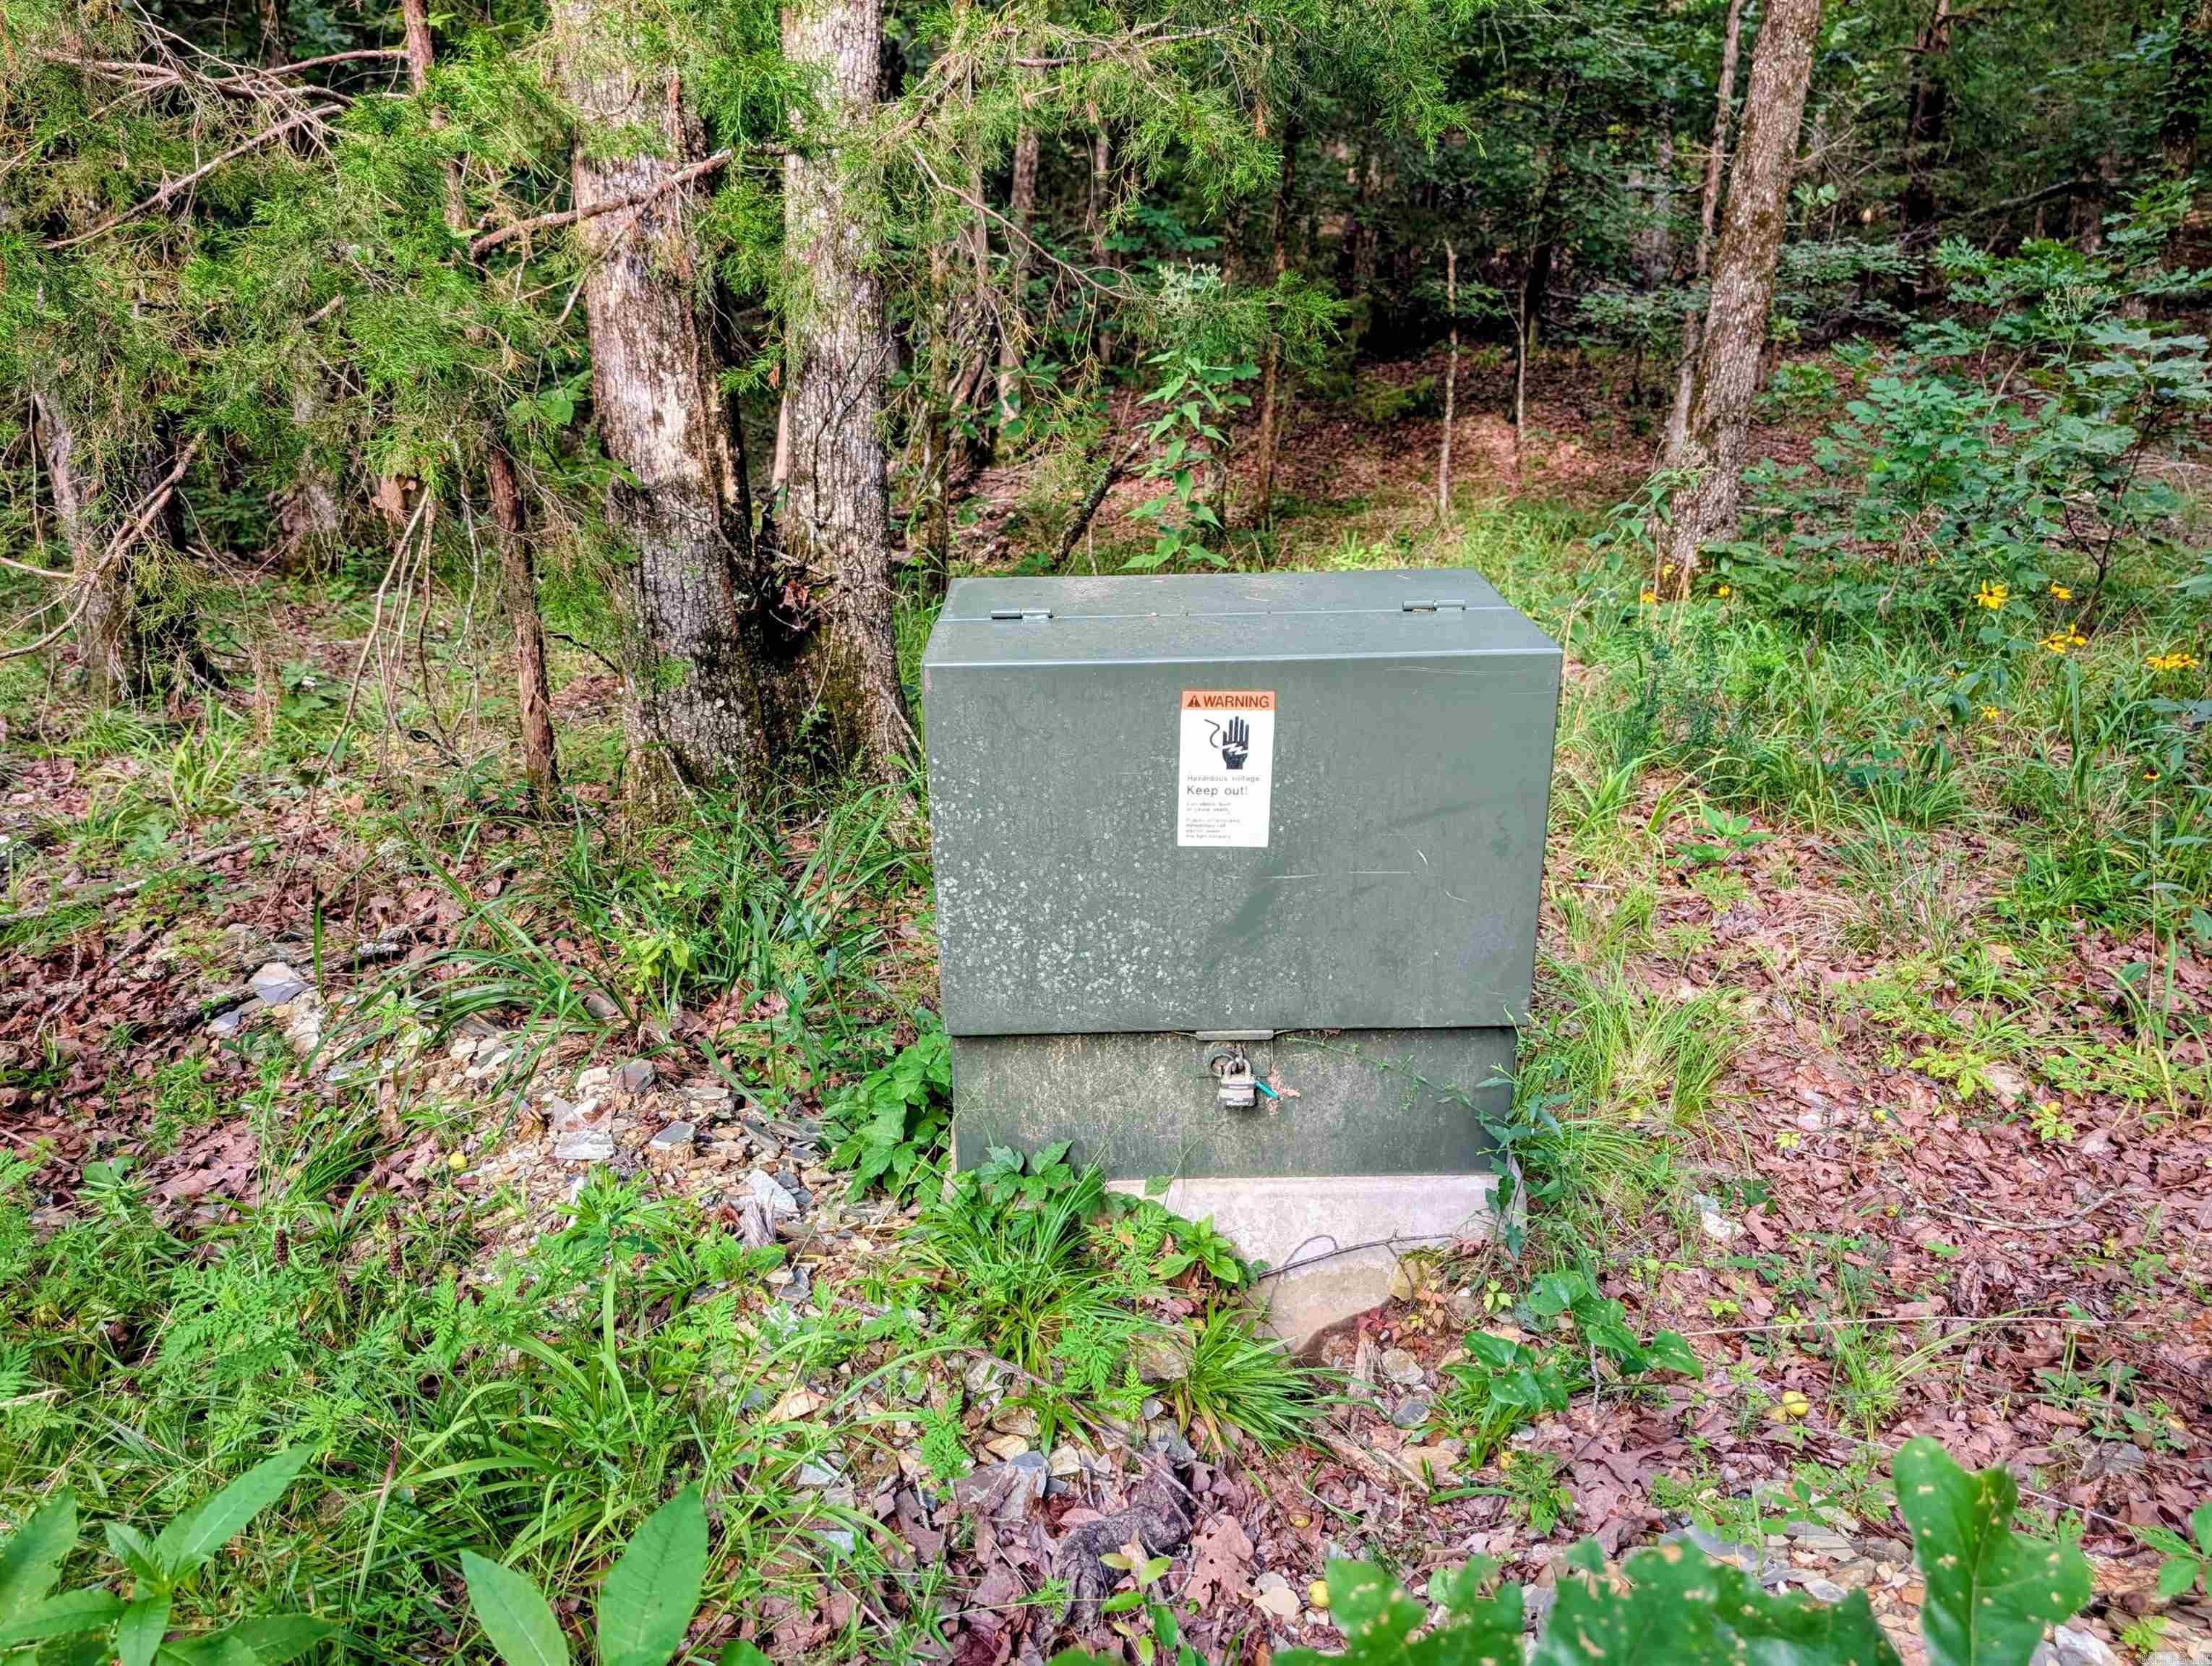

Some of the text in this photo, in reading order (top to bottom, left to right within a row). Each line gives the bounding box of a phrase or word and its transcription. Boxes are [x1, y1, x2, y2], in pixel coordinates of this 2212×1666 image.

[1203, 695, 1270, 708] WARNING
[1186, 785, 1249, 798] Keep out!
